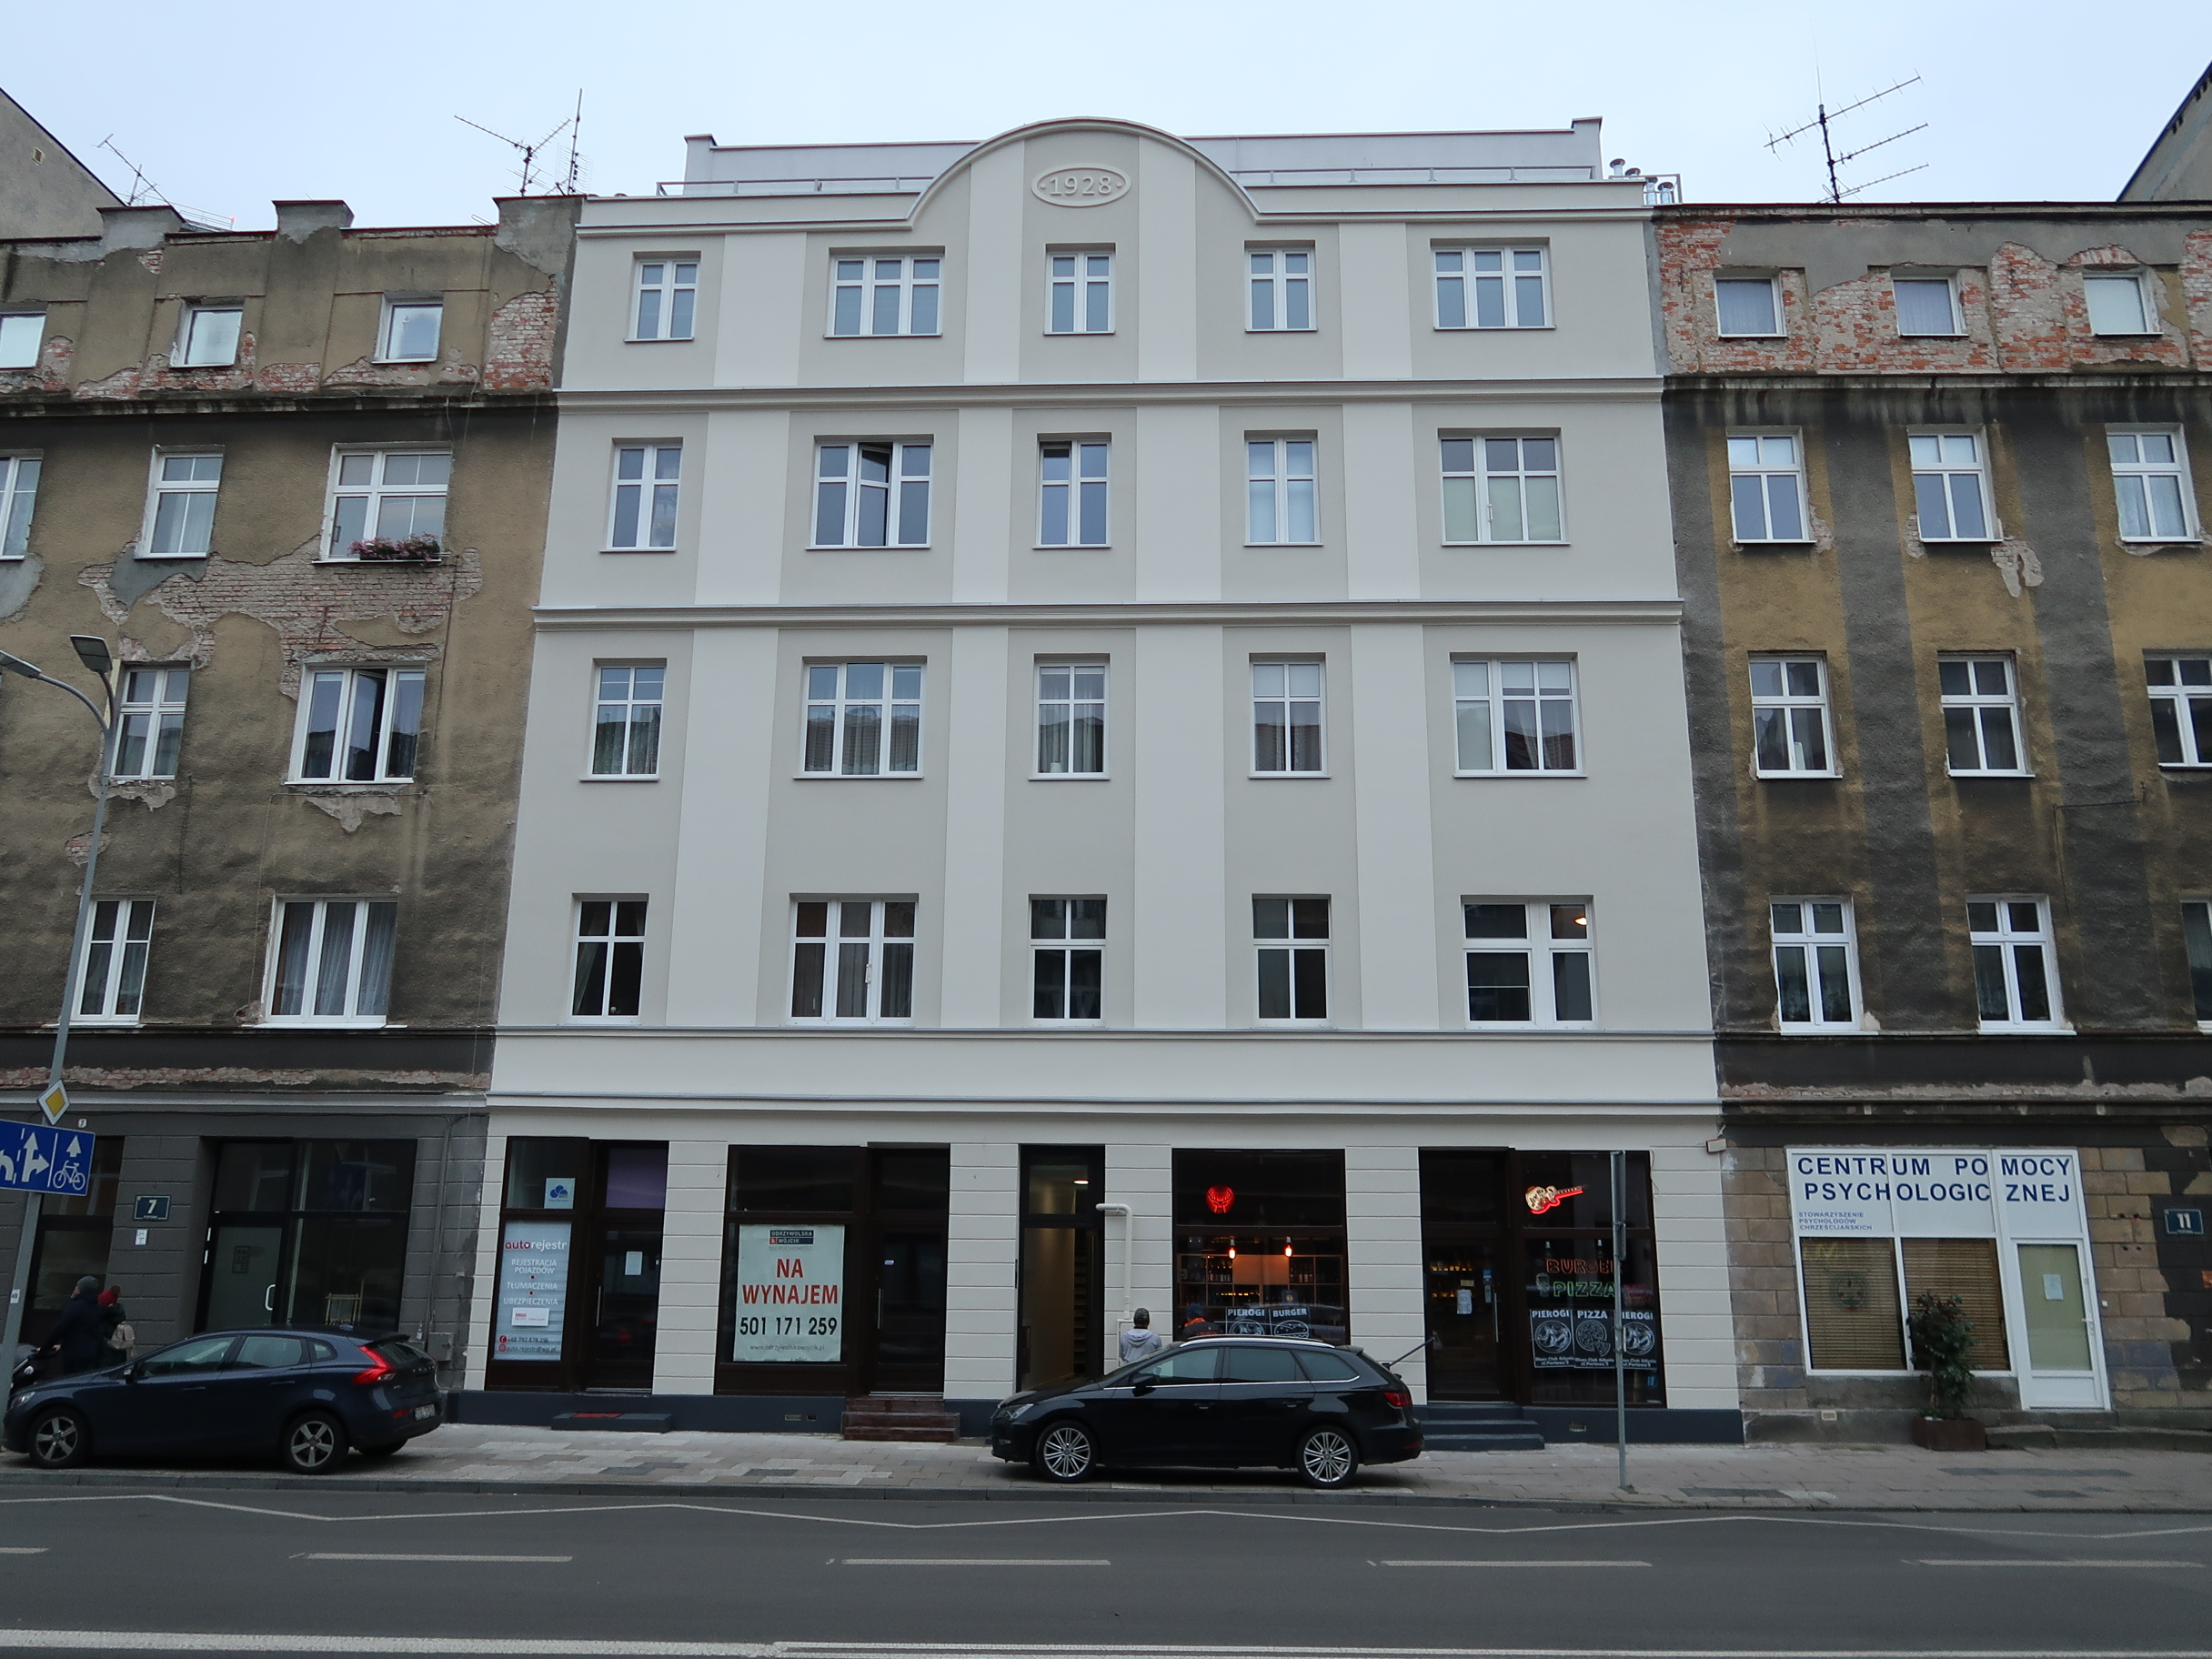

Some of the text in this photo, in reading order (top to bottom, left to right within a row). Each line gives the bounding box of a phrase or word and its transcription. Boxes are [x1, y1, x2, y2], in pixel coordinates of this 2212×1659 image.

[1050, 176, 1112, 196] 1928
[1797, 1157, 1931, 1175] CENTRUM
[147, 1199, 157, 1214] 7
[2176, 1213, 2191, 1229] 11
[505, 1240, 568, 1252] autorejestr
[511, 1259, 557, 1267] REJESTRACJA
[514, 1265, 556, 1274] POJAZDÓW
[776, 1259, 804, 1279] NA
[507, 1282, 558, 1291] TŁUMACZENIA
[1553, 1282, 1615, 1298] PIZZA
[742, 1284, 839, 1305] WYNAJEM
[503, 1297, 558, 1306] UBEZPIECZENIA
[1227, 1308, 1265, 1317] PIEROGI
[1272, 1308, 1308, 1318] BURGER
[1532, 1310, 1570, 1318] PIEROGI
[1577, 1311, 1608, 1319] PIZZA
[1621, 1311, 1654, 1320] IEROGI
[739, 1316, 838, 1335] 501 171 259
